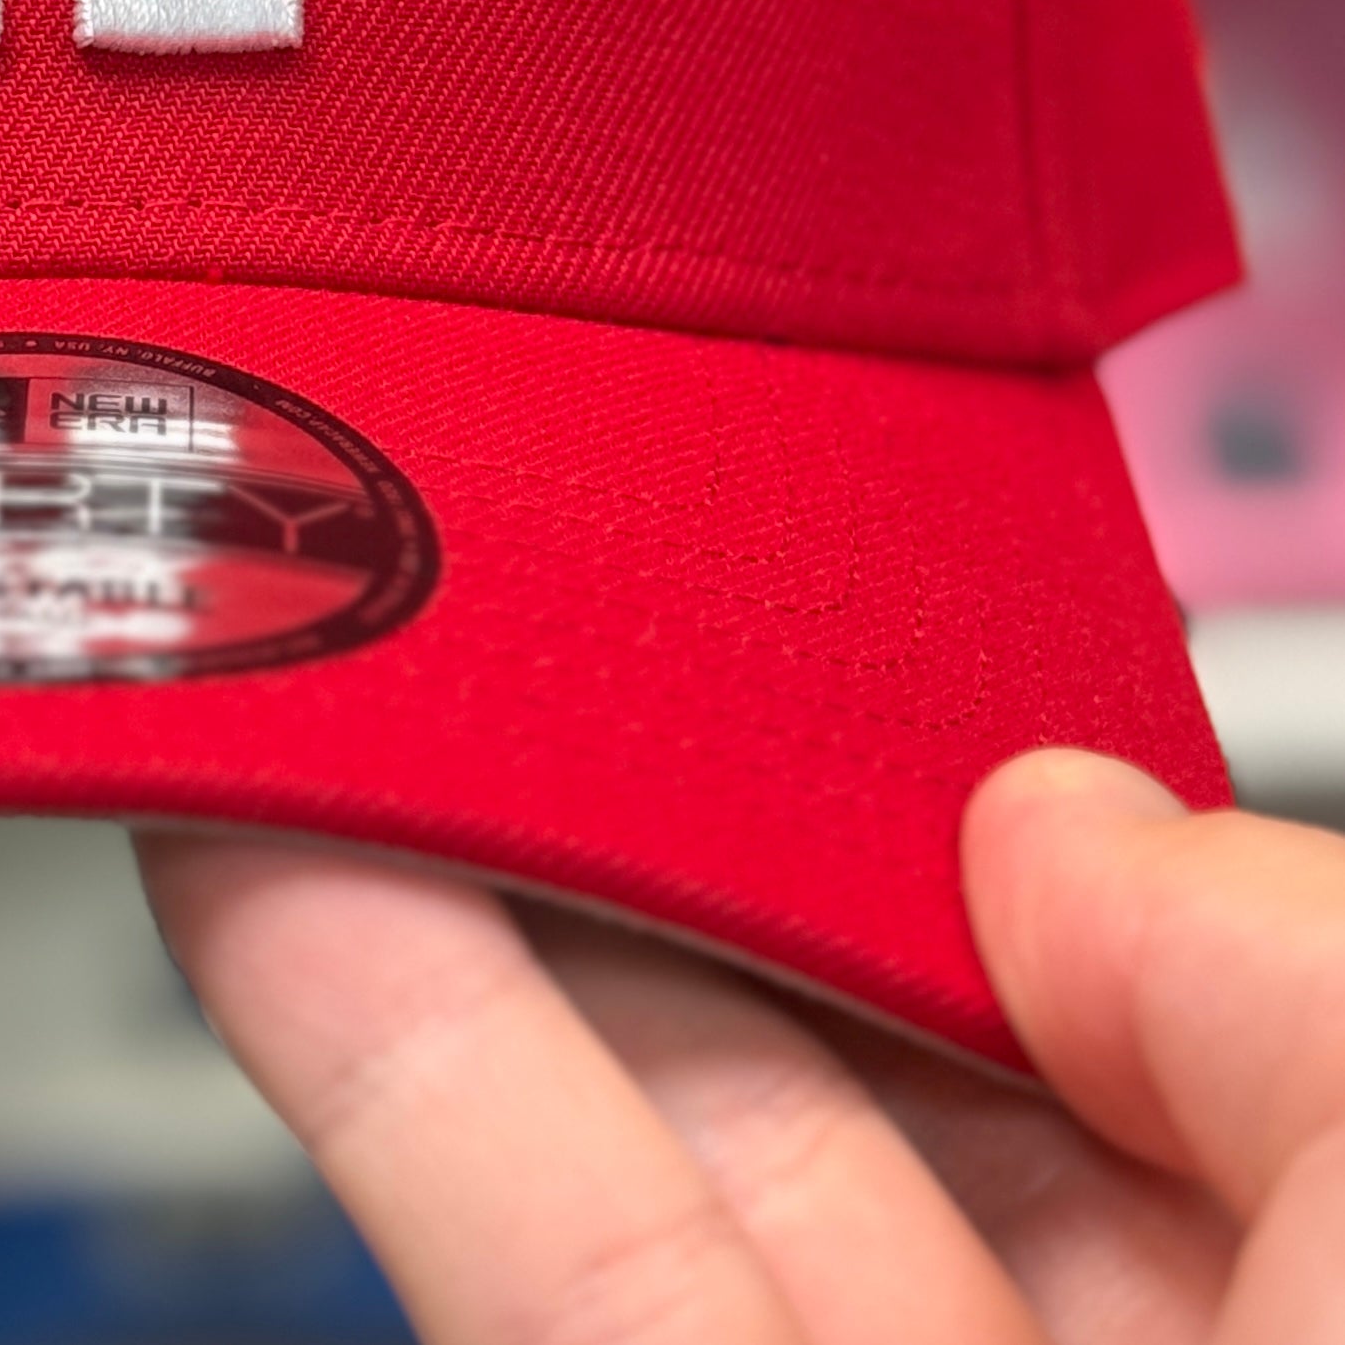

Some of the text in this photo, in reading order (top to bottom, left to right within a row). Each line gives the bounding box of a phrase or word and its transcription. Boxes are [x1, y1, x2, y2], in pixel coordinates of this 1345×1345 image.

[54, 340, 91, 352] USA
[50, 391, 168, 416] NEW
[49, 410, 167, 436] ERA
